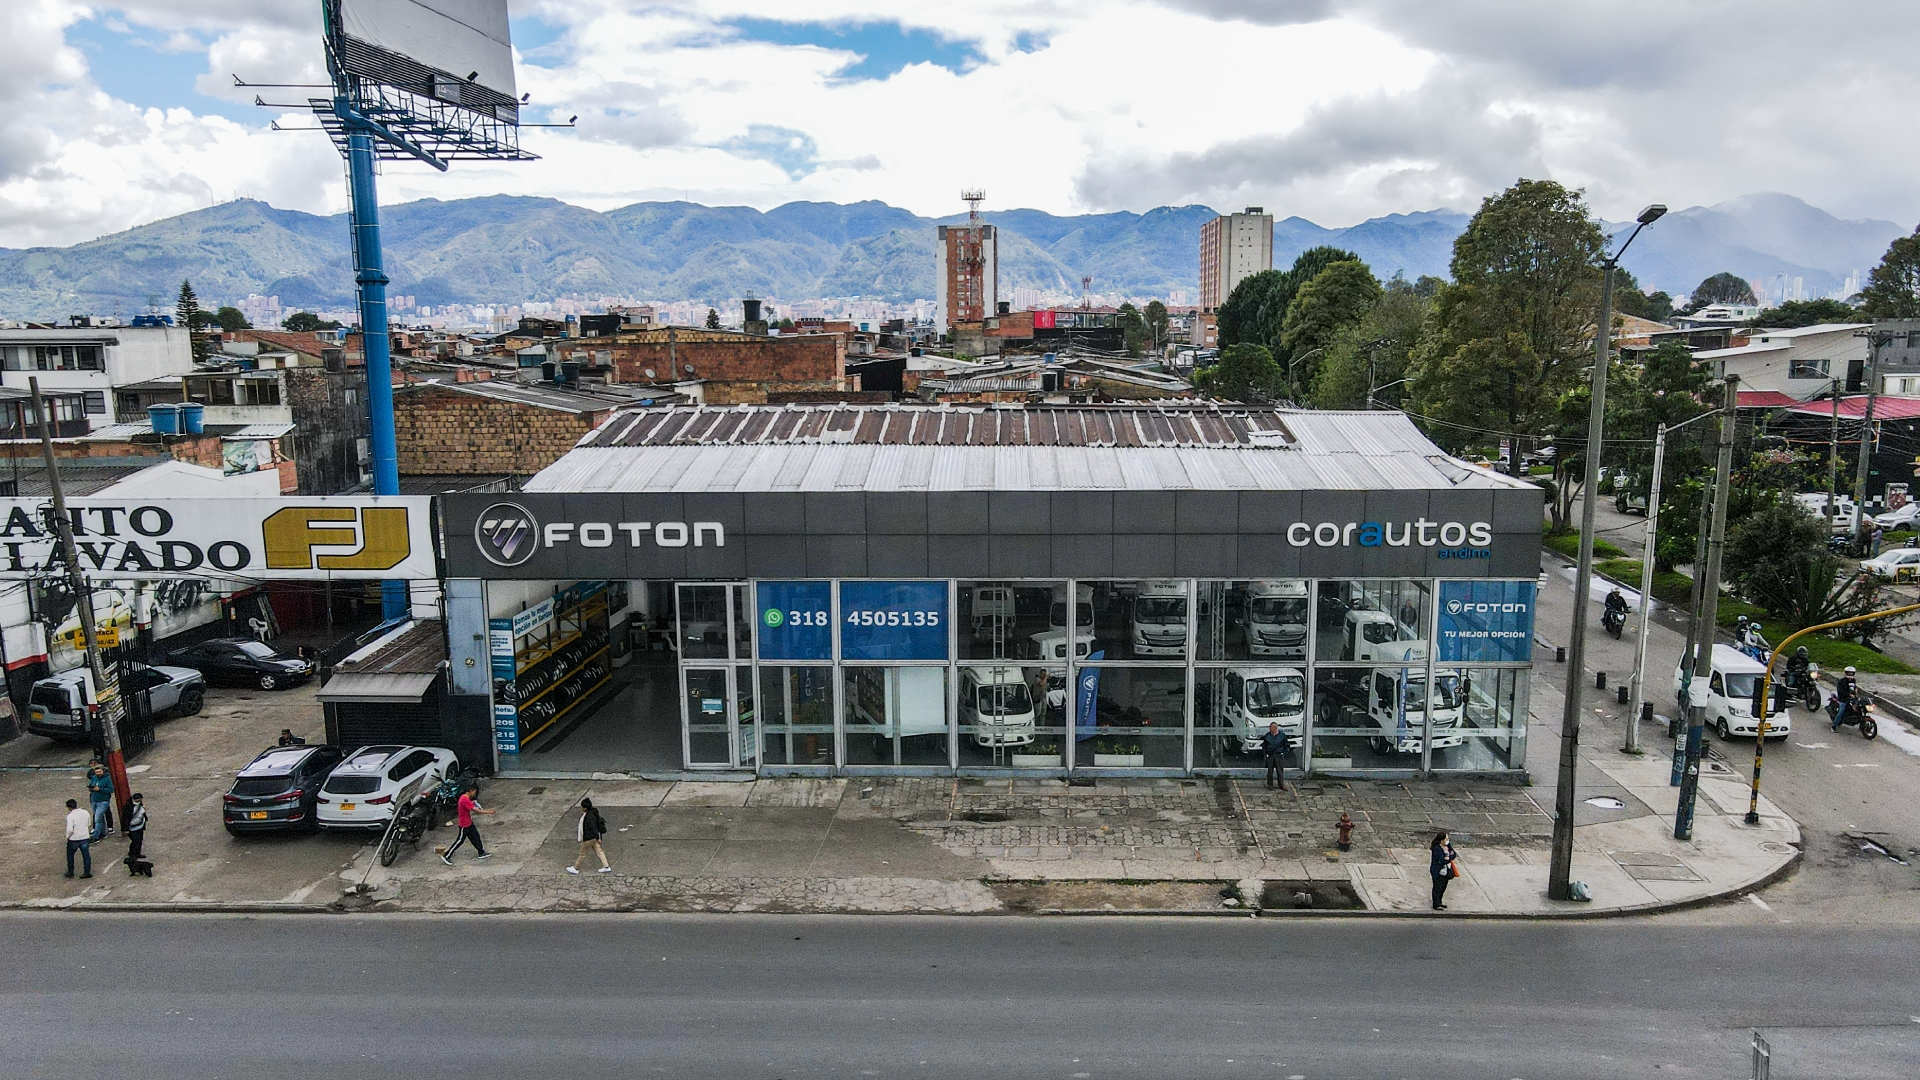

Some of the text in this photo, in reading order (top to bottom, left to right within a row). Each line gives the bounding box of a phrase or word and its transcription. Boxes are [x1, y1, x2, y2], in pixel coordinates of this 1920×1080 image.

[0, 505, 174, 538] AUTO
[1286, 517, 1492, 547] corautos
[6, 540, 251, 572] LAVADO
[1438, 547, 1492, 560] andino
[789, 610, 939, 627] 318 4505135
[1444, 629, 1526, 638] TU MEJOR OPCIÓN
[497, 743, 516, 751] 235
